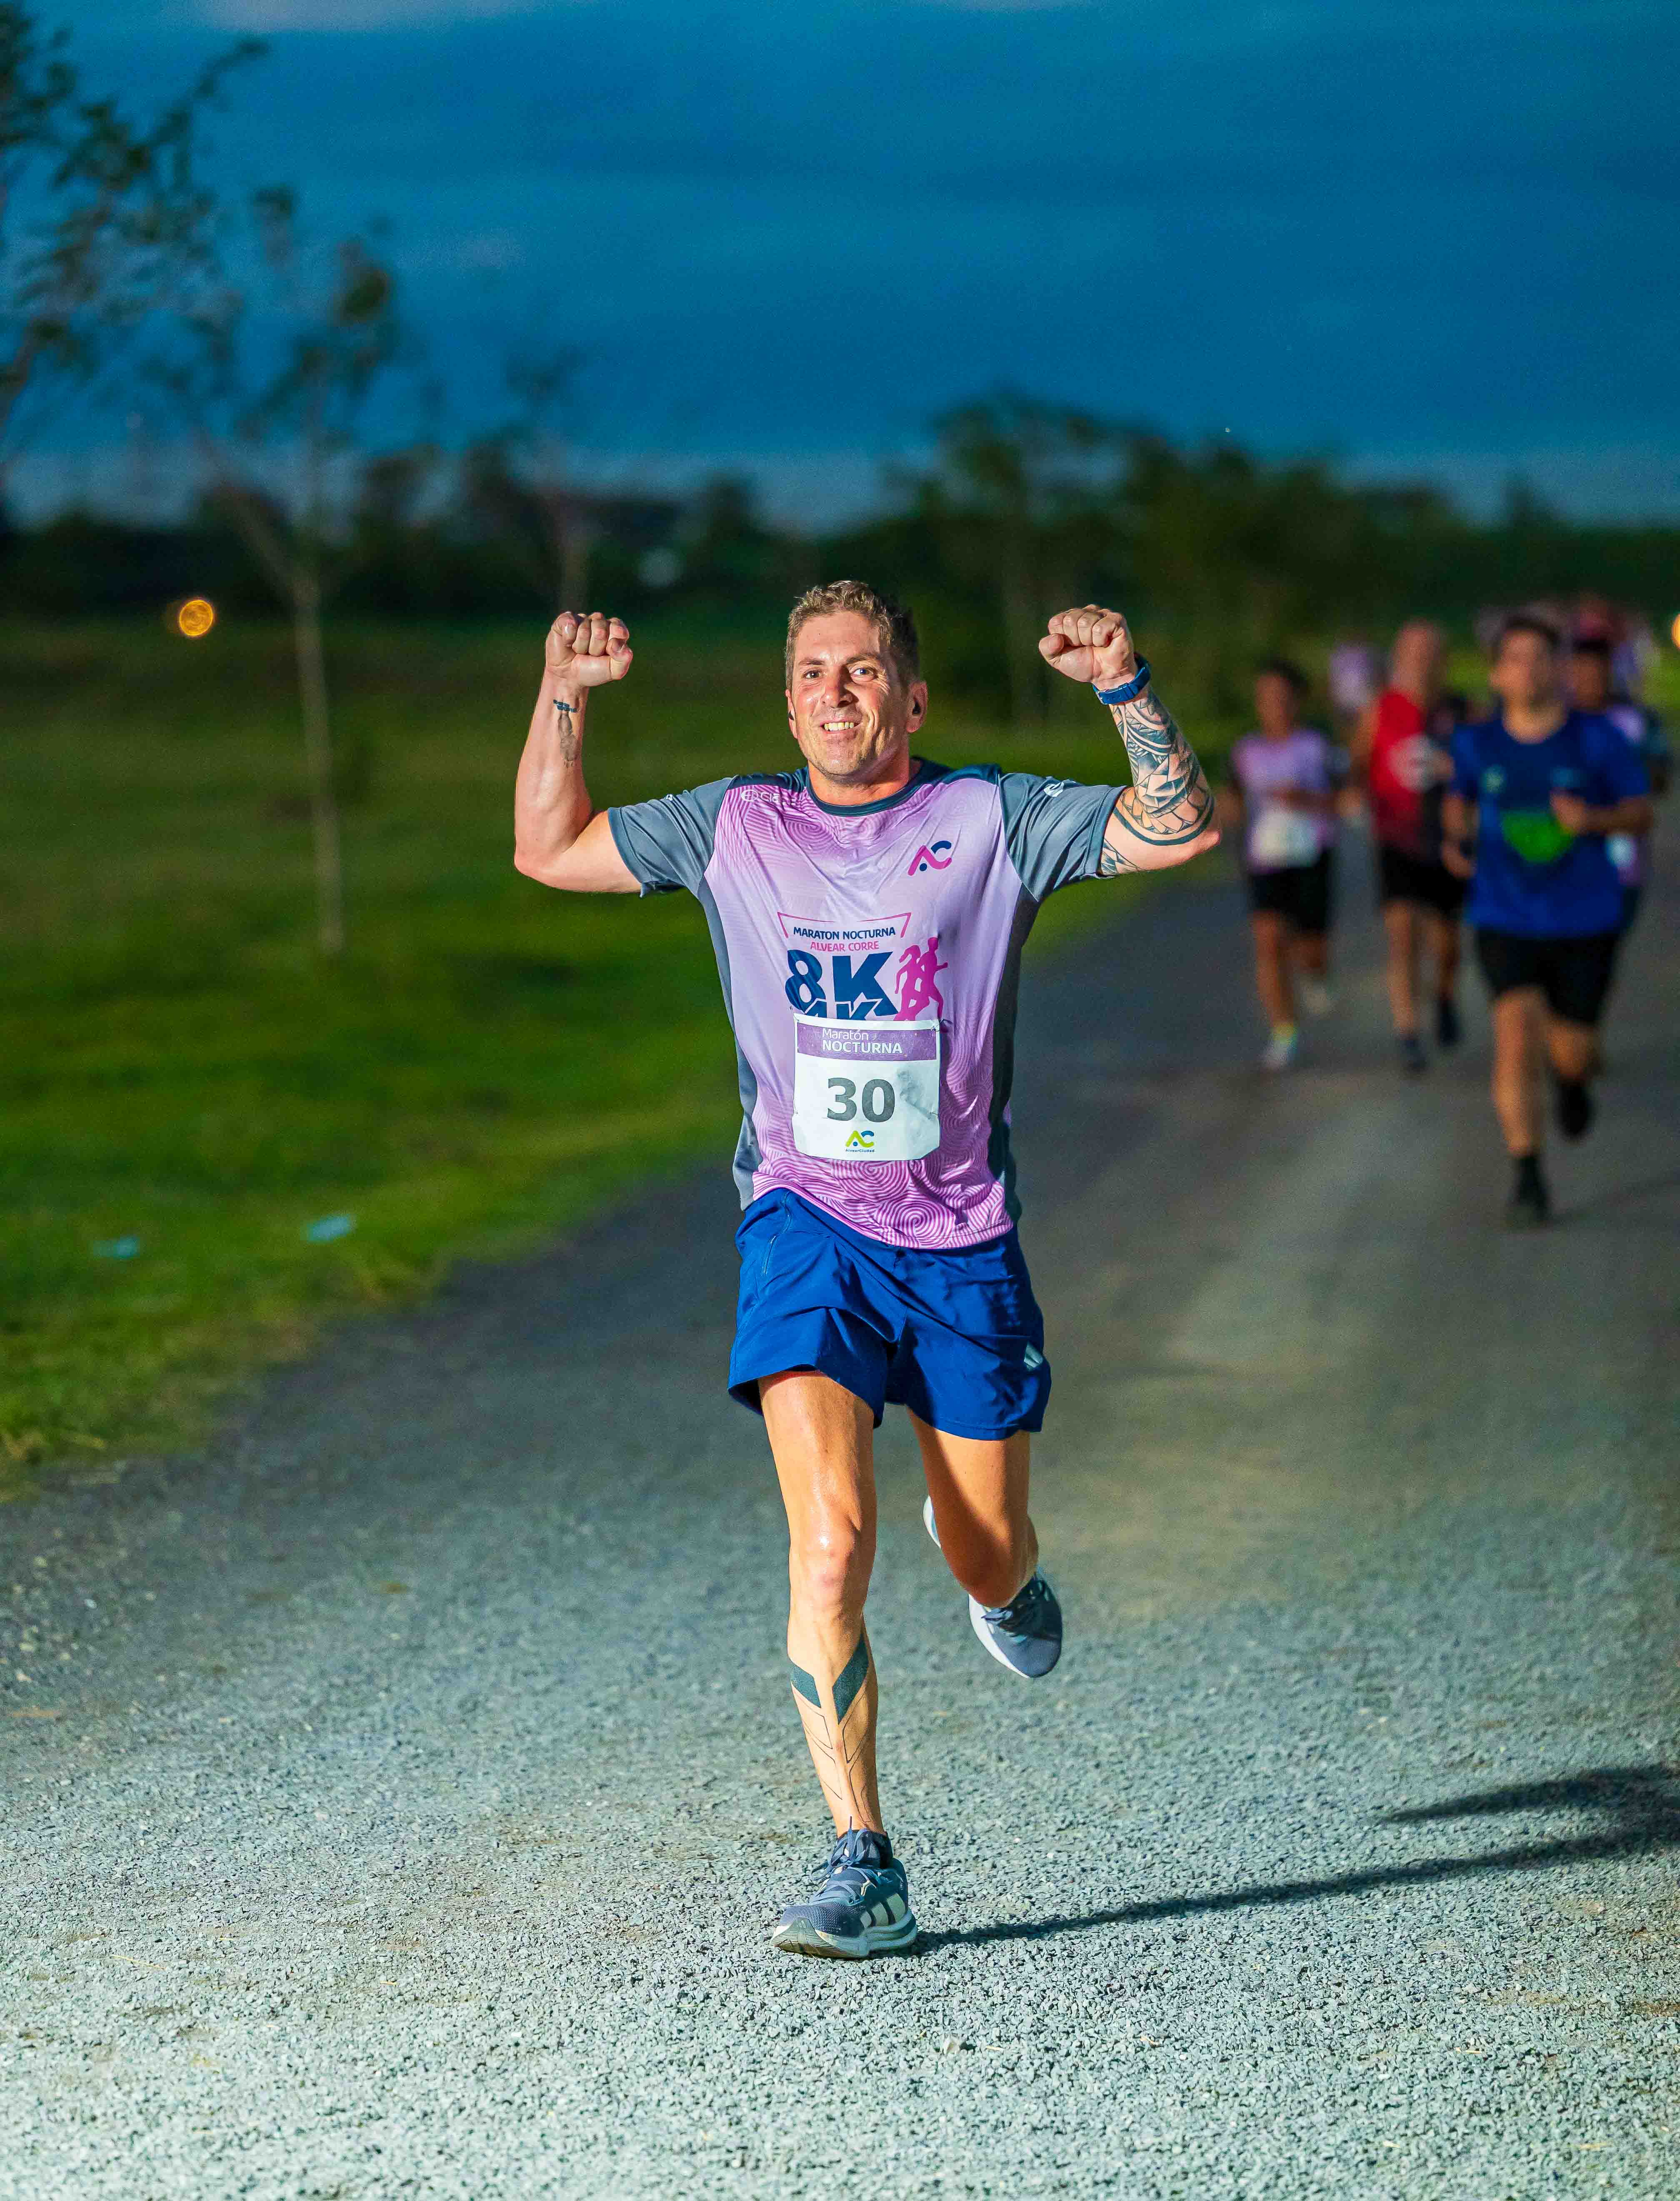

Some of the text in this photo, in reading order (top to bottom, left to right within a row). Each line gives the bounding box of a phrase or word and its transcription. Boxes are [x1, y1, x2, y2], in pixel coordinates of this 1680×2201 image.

[793, 926, 896, 940] MARATON NOCTURNA
[810, 941, 880, 952] ALVEAR CORRE
[785, 949, 899, 1016] 8K
[822, 1028, 869, 1041] Maratón
[822, 1040, 903, 1054] NOCTURNA
[827, 1077, 895, 1122] 30
